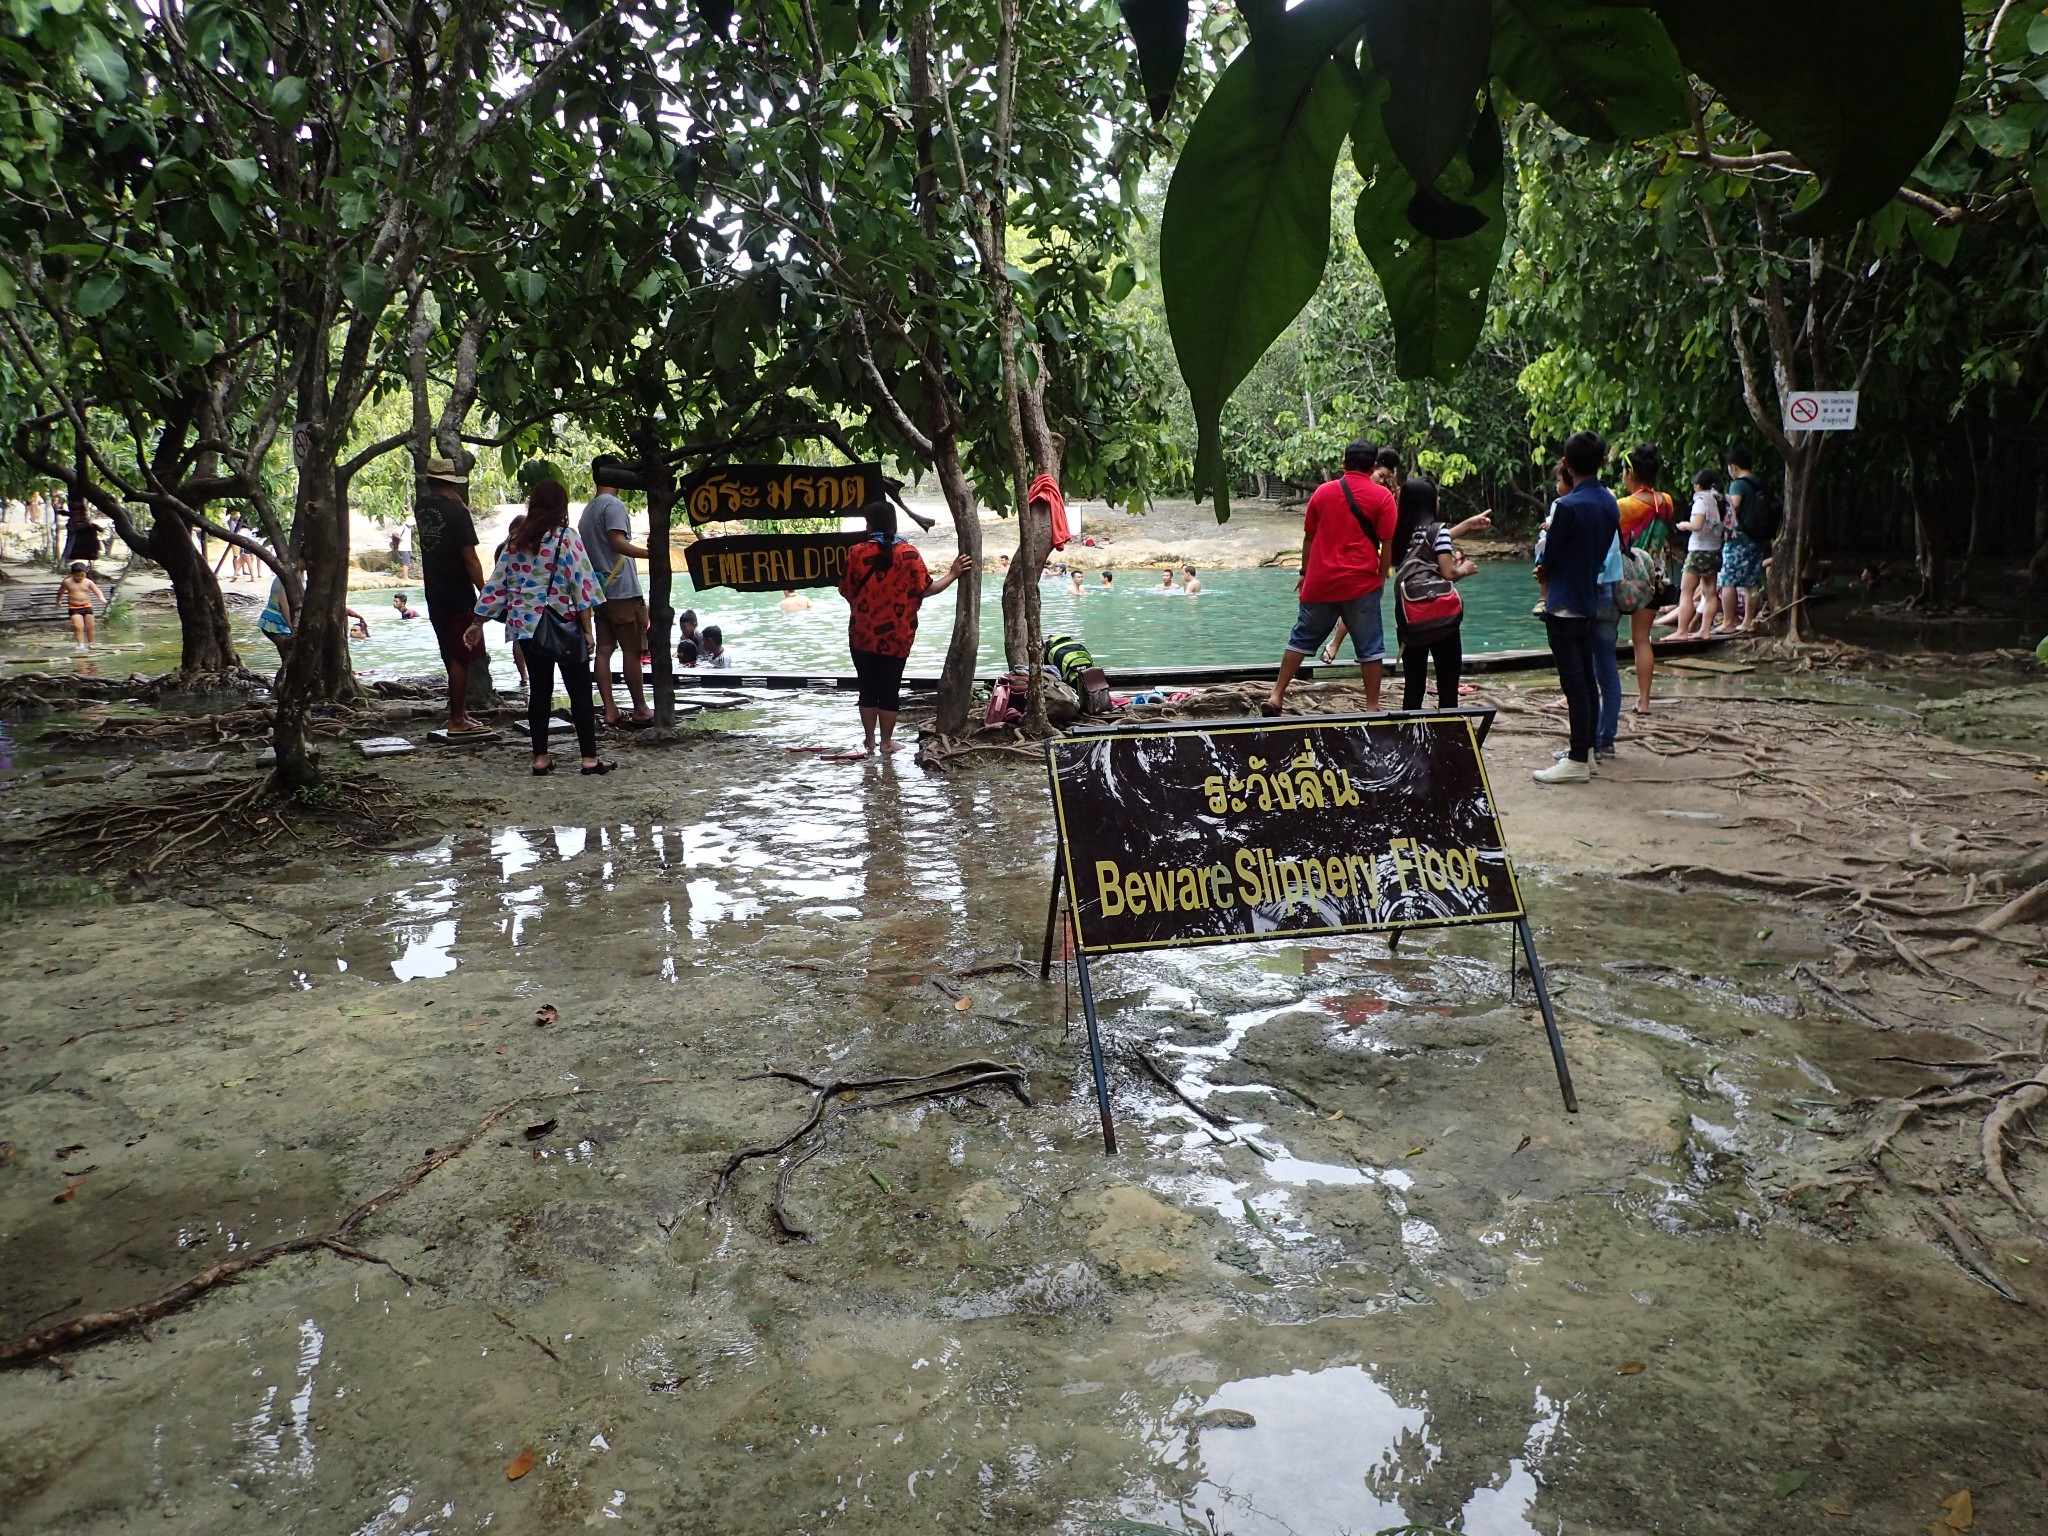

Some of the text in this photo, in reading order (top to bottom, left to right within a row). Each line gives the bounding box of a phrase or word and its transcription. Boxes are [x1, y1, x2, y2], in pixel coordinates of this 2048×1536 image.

[1204, 738, 1359, 813] ระวังลื่น
[1096, 837, 1489, 917] Beware Slippery Floor.
